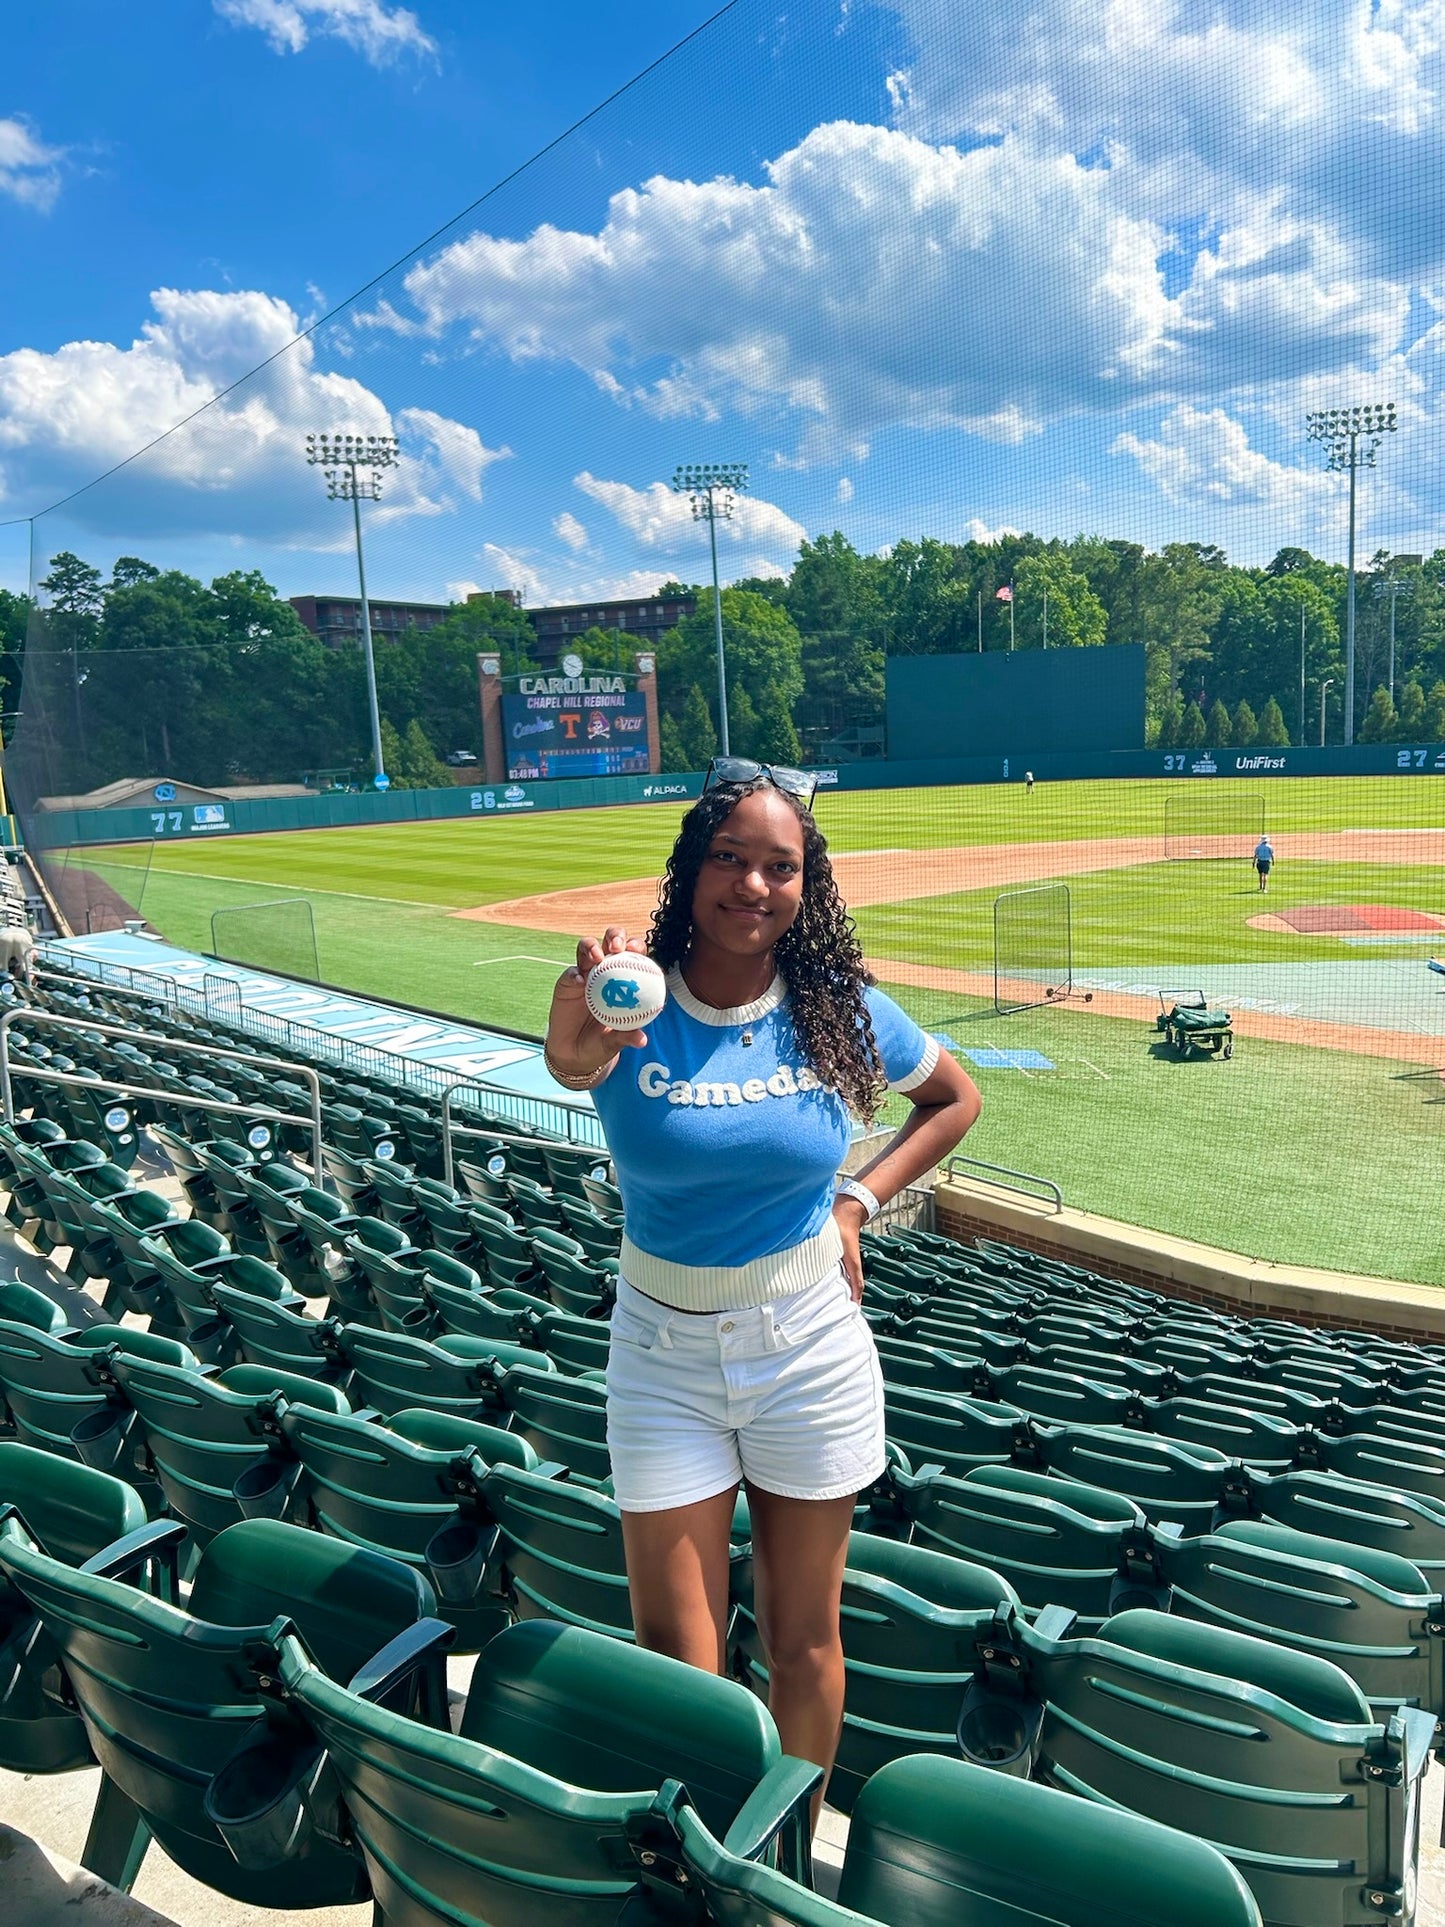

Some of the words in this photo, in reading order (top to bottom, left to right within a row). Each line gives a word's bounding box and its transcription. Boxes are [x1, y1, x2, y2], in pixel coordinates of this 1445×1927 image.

[520, 677, 627, 695] CAROLINA
[527, 696, 562, 709] CHAPEL
[563, 695, 582, 708] HILL
[584, 695, 626, 708] REGIONAL
[559, 714, 581, 739] T
[619, 716, 643, 731] VCU
[1163, 754, 1186, 771] 37
[1235, 756, 1286, 769] UniFirst
[1397, 750, 1428, 767] 27
[653, 785, 687, 795] ALPACA
[470, 791, 496, 809] 26
[151, 811, 183, 832] 77
